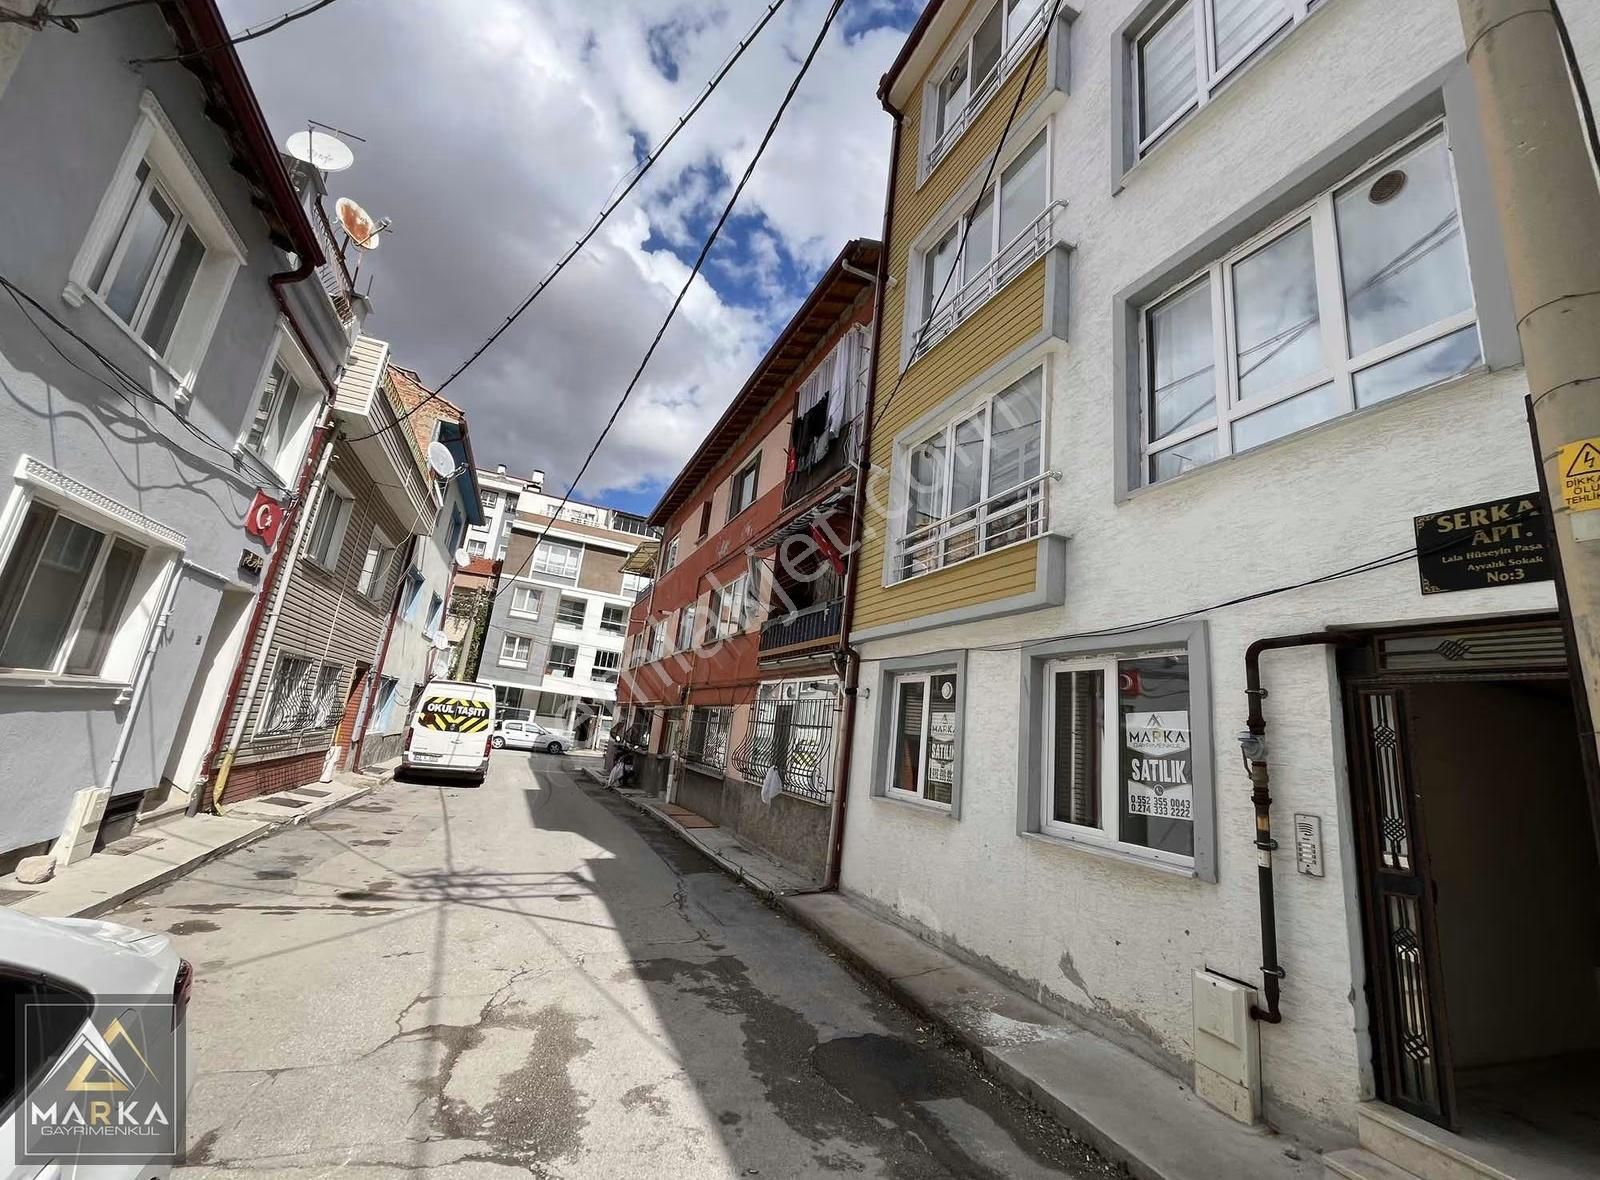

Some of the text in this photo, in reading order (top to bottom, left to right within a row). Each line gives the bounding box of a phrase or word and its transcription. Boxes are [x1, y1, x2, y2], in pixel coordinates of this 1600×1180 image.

[1487, 568, 1525, 583] No:3
[427, 703, 486, 717] OKUL TAŞITI
[1129, 730, 1186, 743] MARKA
[1131, 758, 1187, 783] SATILIK
[1131, 795, 1191, 809] 0.552 355 0043
[1153, 806, 1168, 816] 333
[1170, 808, 1191, 818] 2222
